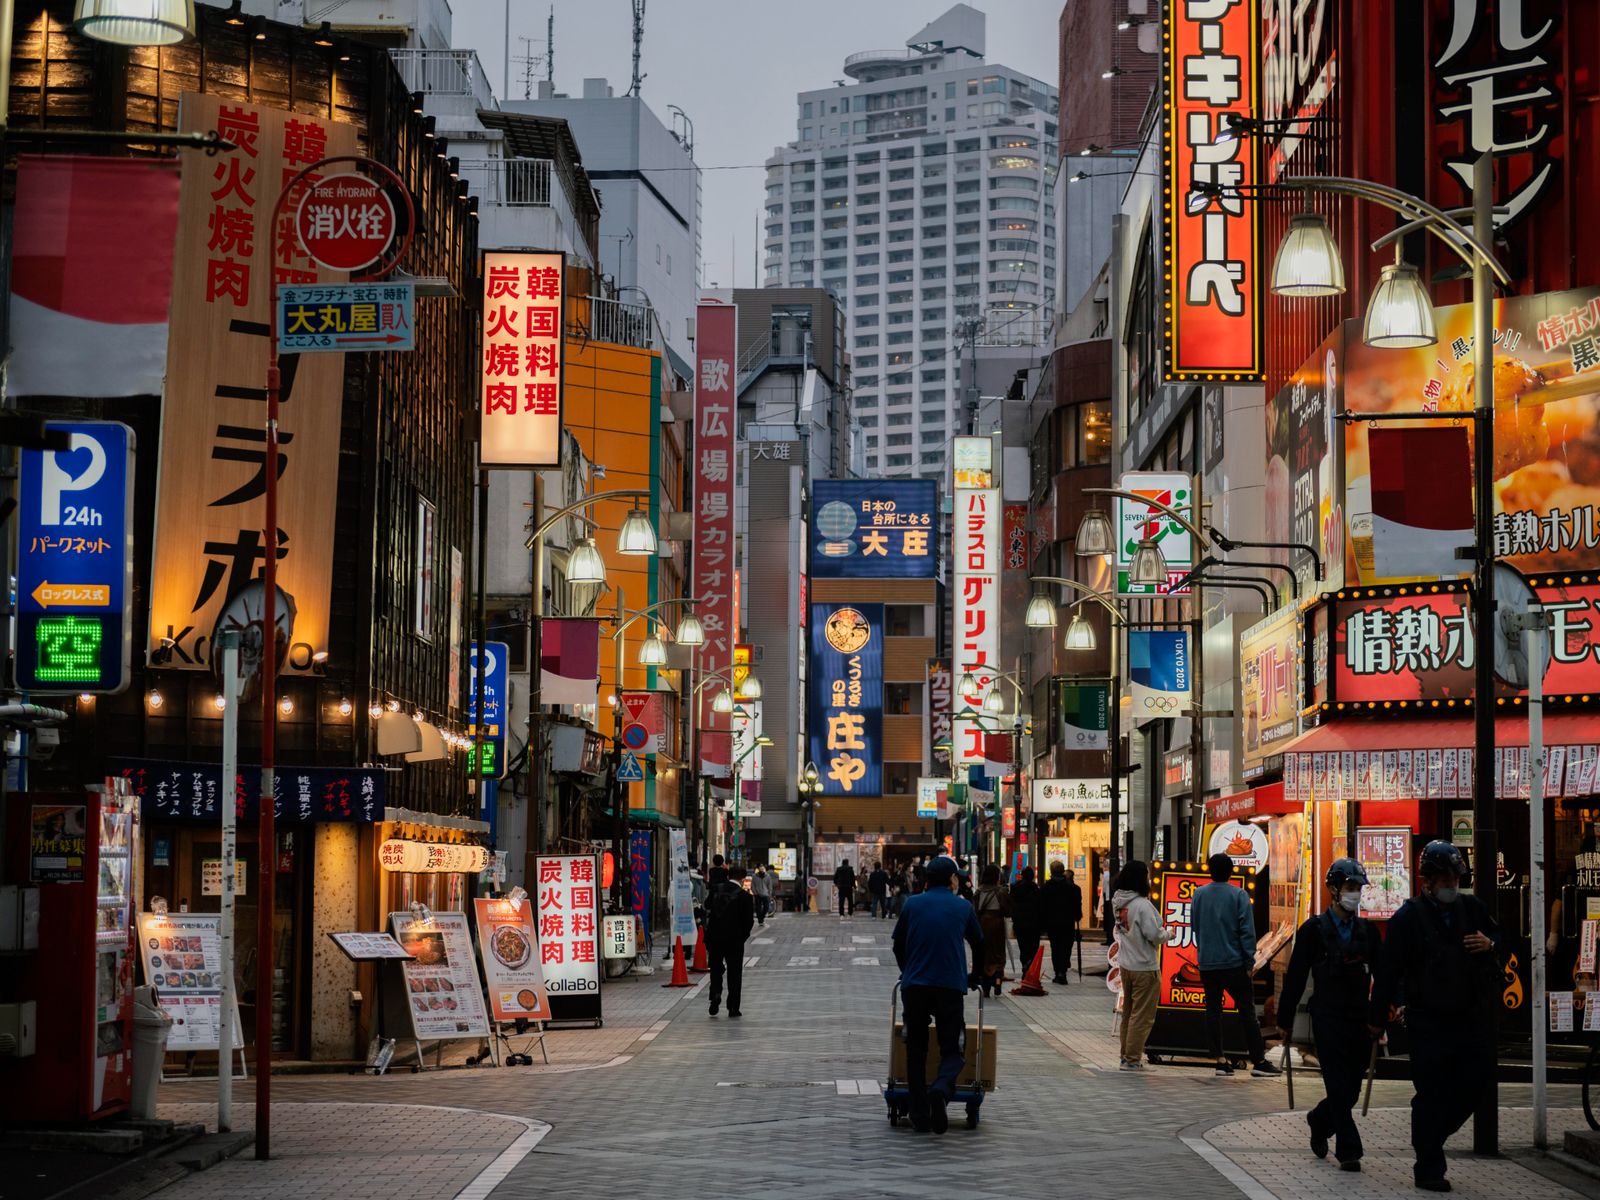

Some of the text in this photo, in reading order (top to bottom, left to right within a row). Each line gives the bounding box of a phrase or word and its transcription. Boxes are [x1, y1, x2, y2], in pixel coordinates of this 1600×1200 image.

[206, 105, 260, 306] 炭火焼肉
[314, 187, 377, 198] FIRE HYDRANT
[307, 203, 386, 240] 消火栓
[287, 303, 409, 334] 大丸屋 買入
[284, 335, 332, 347] ここ入る
[485, 266, 520, 415] 炭火焼肉
[524, 266, 560, 415] 韓国料理
[752, 442, 791, 460] 大雄
[861, 500, 896, 513] 日本の
[1294, 468, 1315, 518] EXTRA
[63, 505, 103, 527] 24h
[872, 513, 931, 525] 台所になる
[968, 494, 985, 570] パチスロ
[30, 537, 111, 554] パークネット
[862, 530, 929, 557] 大庄
[41, 588, 104, 602] ロックレス式
[35, 616, 102, 682] 空
[1174, 638, 1185, 689] TOKYO 2020
[848, 656, 862, 707] くつろぎ
[626, 698, 646, 706] 止まれ
[1098, 690, 1106, 712] TOKYO
[827, 711, 866, 792] 庄や
[156, 781, 168, 807] チキン
[169, 771, 181, 816] ヤンニョム
[297, 776, 312, 821] 純豆腐チゲ
[539, 861, 564, 964] 炭火焼肉
[570, 859, 596, 963] 韓国料理
